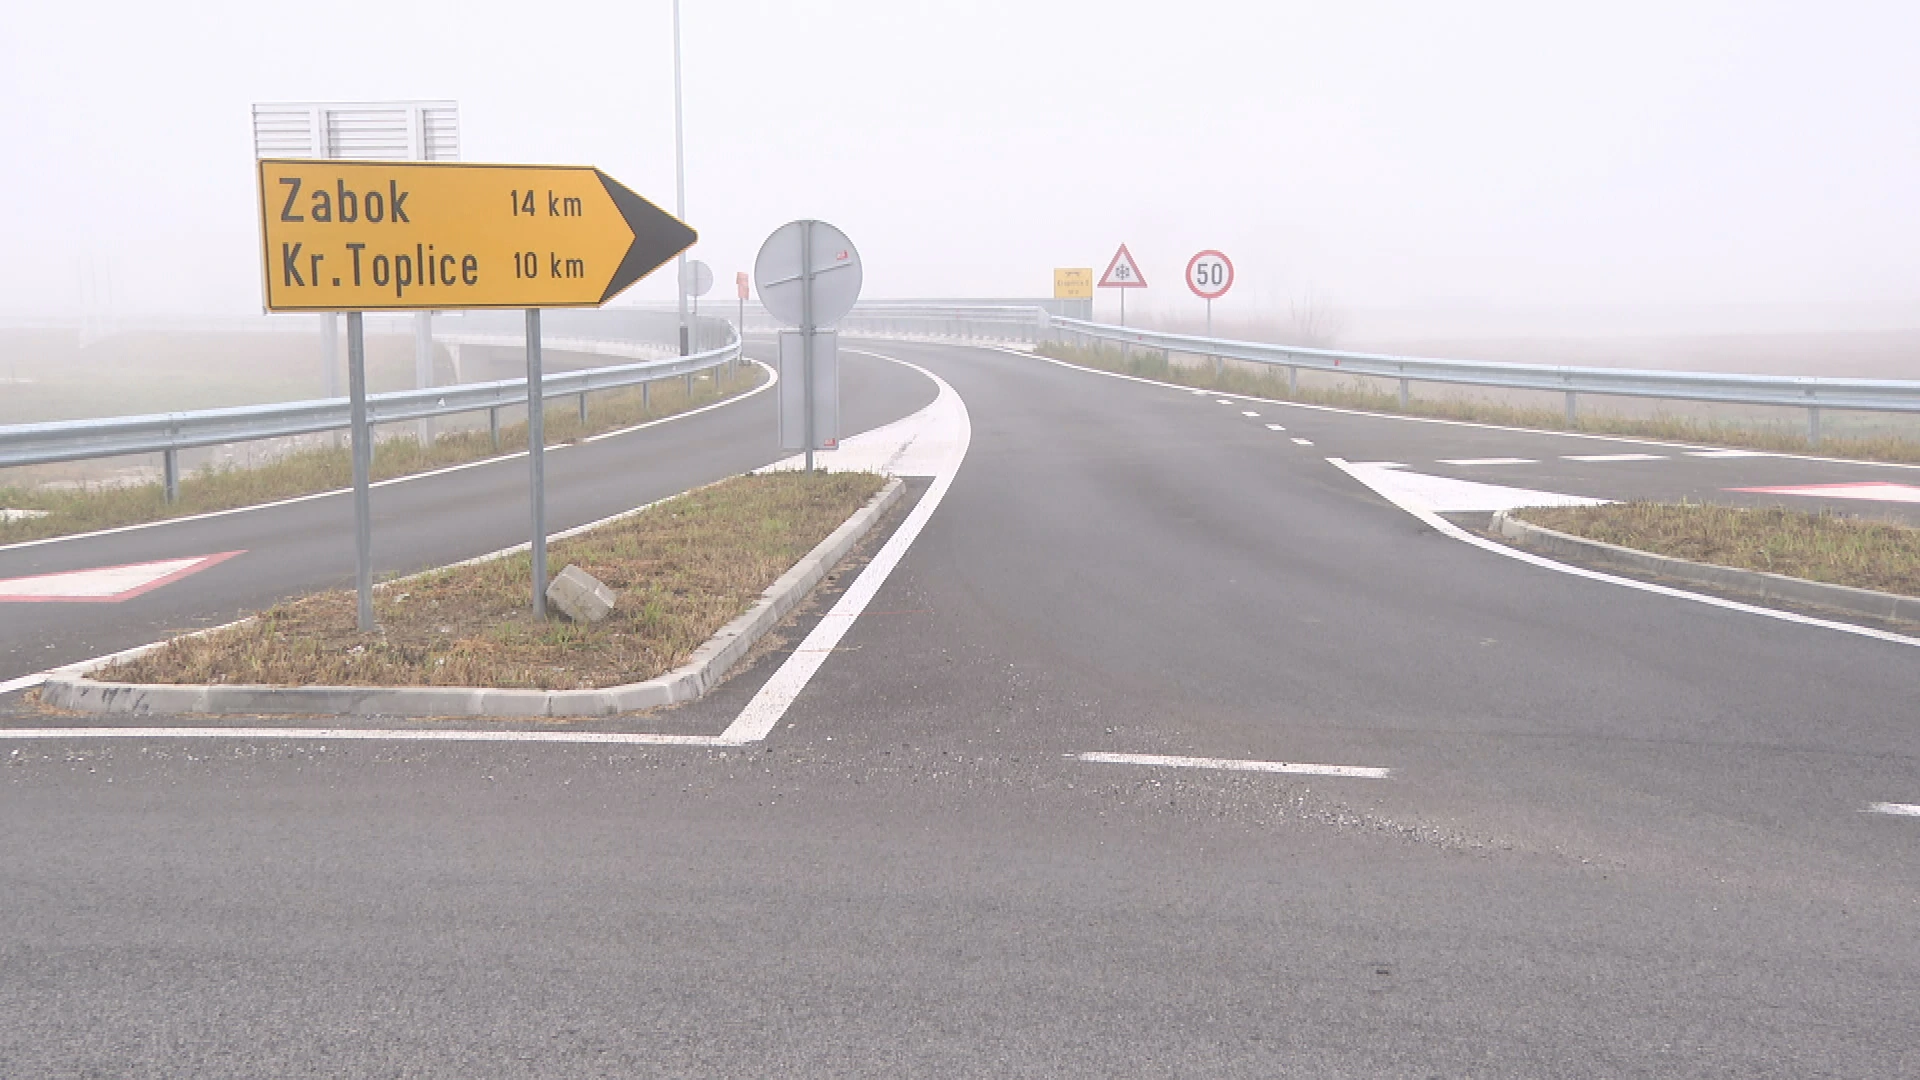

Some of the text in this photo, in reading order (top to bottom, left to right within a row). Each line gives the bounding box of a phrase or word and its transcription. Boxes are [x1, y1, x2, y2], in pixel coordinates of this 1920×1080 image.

[279, 177, 582, 223] Zabok 14 km
[282, 241, 584, 299] Kr.Toplice 10 km
[1196, 263, 1223, 285] 50
